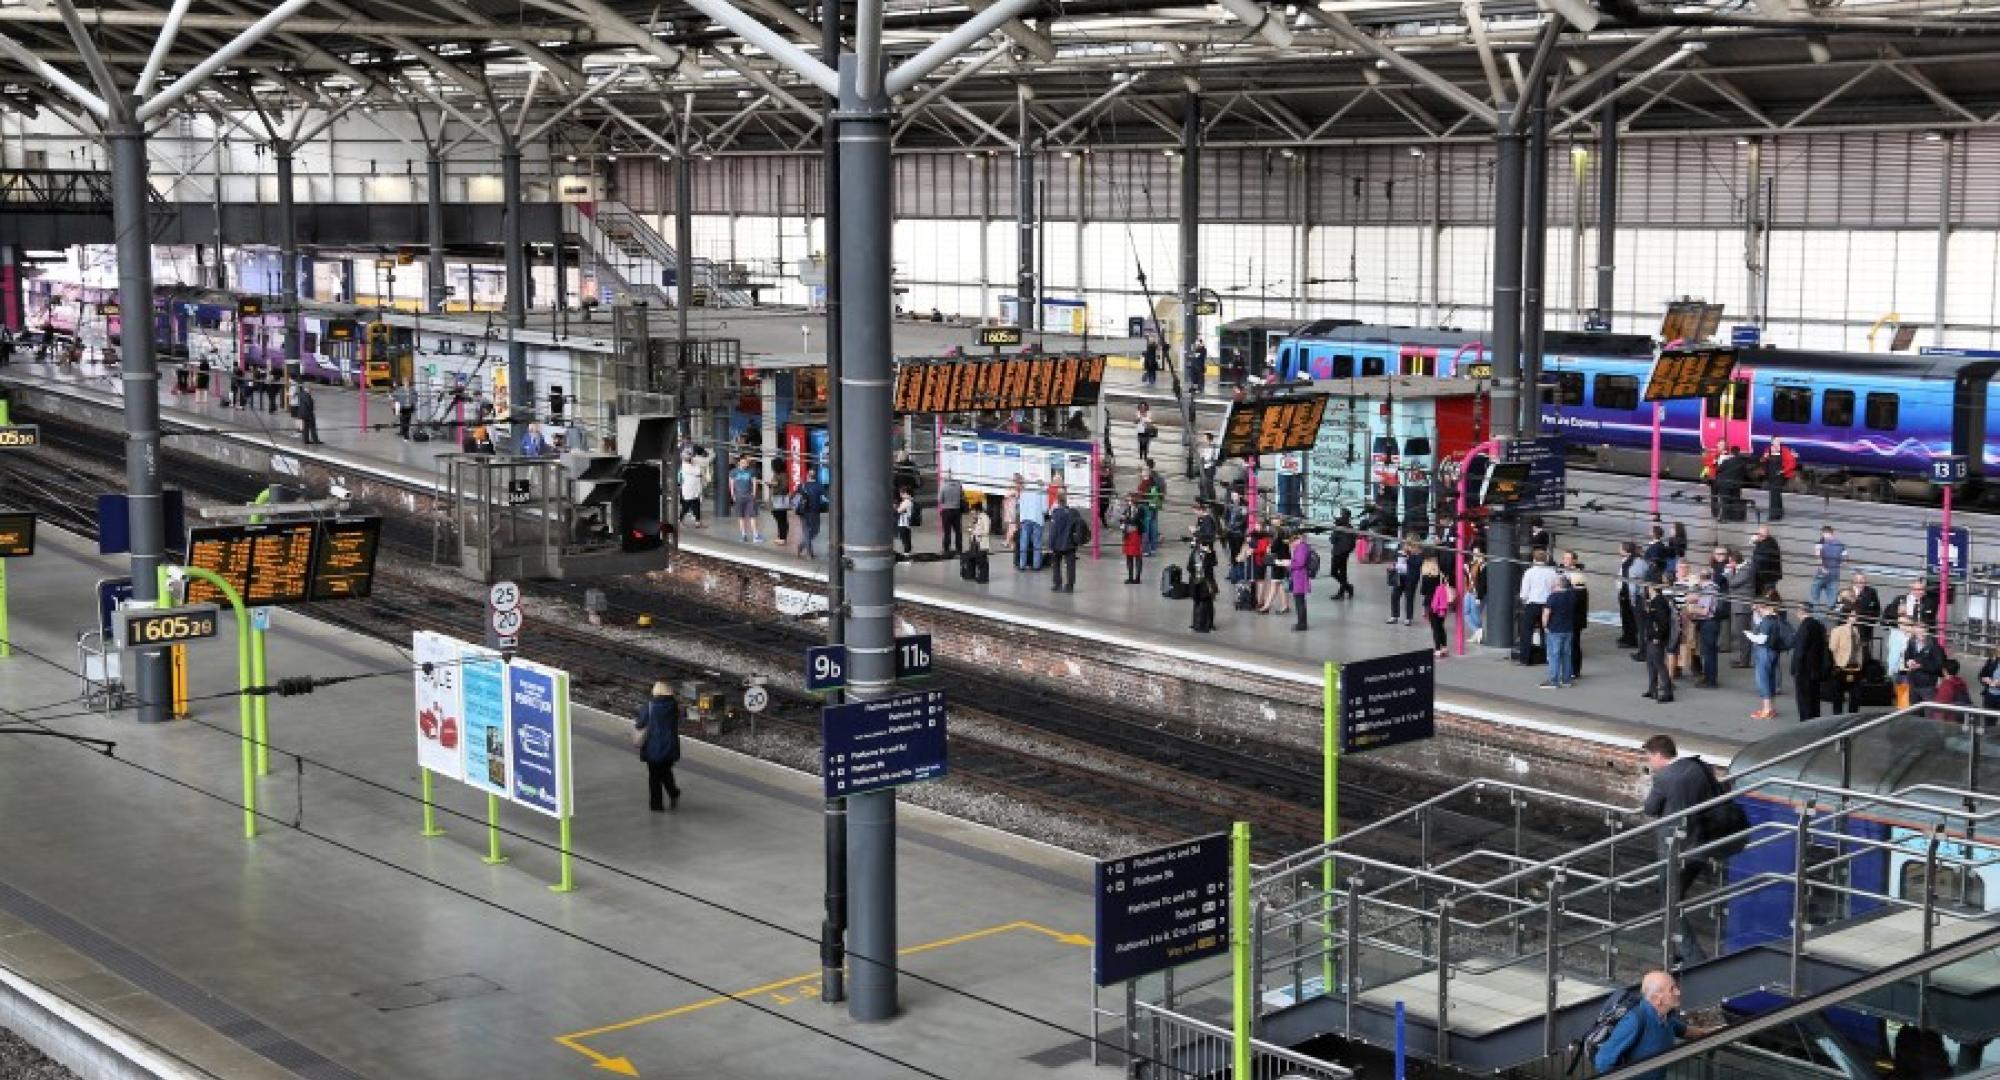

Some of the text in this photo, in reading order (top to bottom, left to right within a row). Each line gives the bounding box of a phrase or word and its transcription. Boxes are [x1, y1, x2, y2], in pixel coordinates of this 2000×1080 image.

[1933, 462, 1950, 478] 13
[495, 587, 515, 605] 25
[498, 609, 517, 629] 20
[901, 643, 930, 669] 11b
[815, 654, 841, 680] 9b
[748, 692, 765, 707] 20
